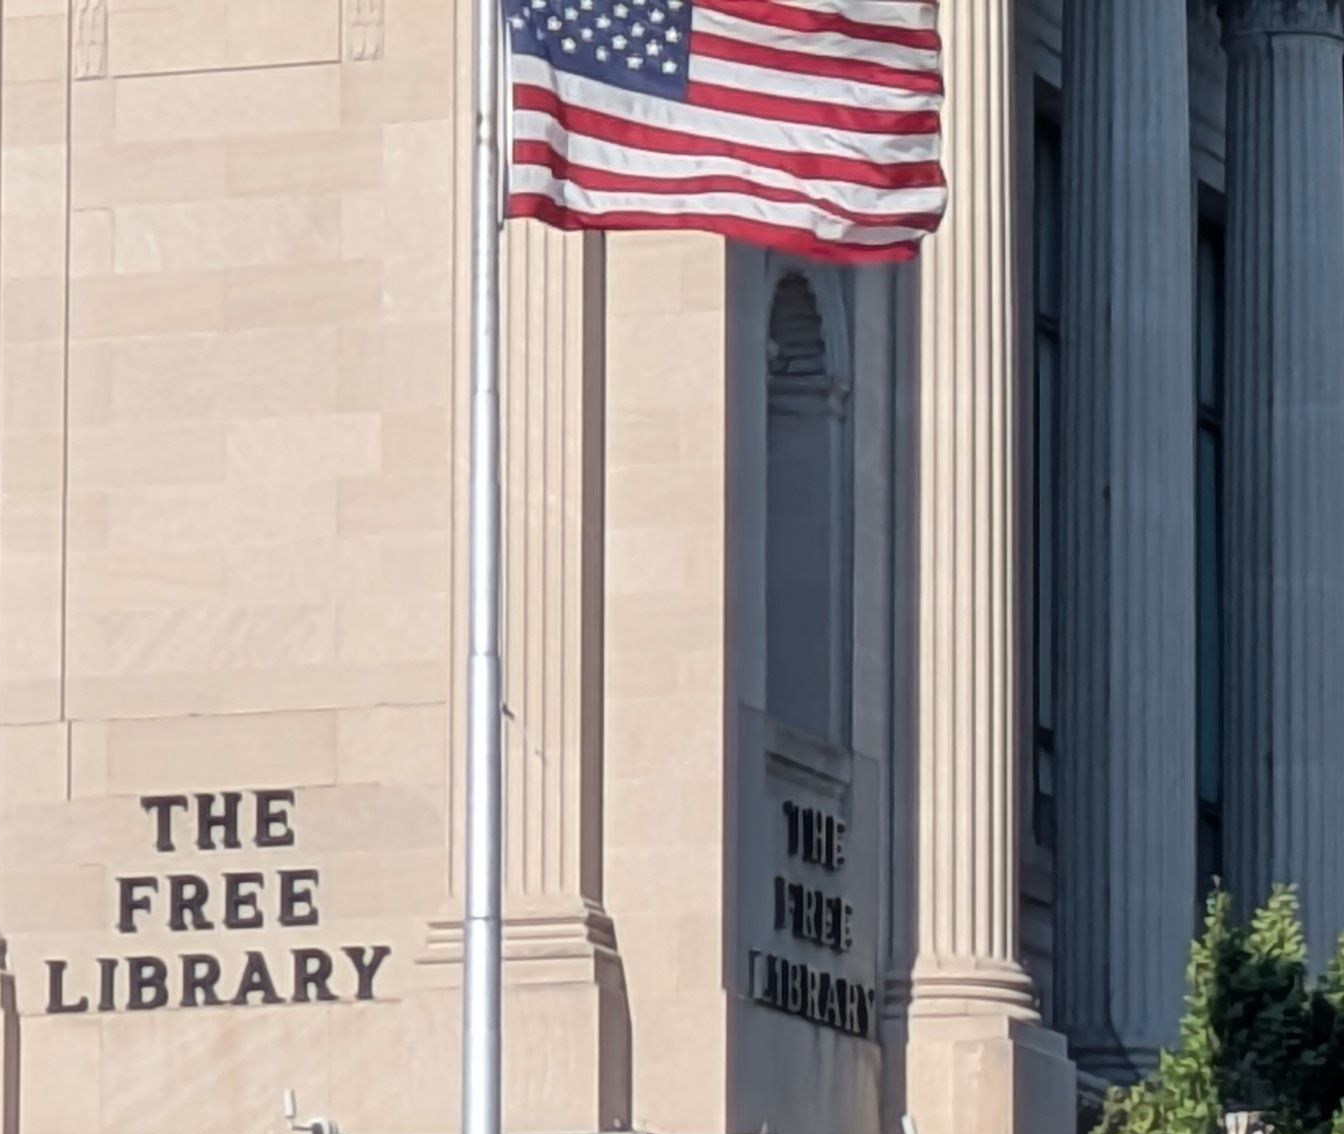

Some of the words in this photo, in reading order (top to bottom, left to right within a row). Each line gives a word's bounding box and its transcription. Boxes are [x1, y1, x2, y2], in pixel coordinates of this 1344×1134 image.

[140, 789, 296, 852] THE
[783, 800, 846, 870] THE
[116, 869, 319, 934] FREE
[774, 876, 853, 955] FREE
[45, 946, 391, 1014] LIBRARY
[749, 949, 876, 1038] LIBRARY
